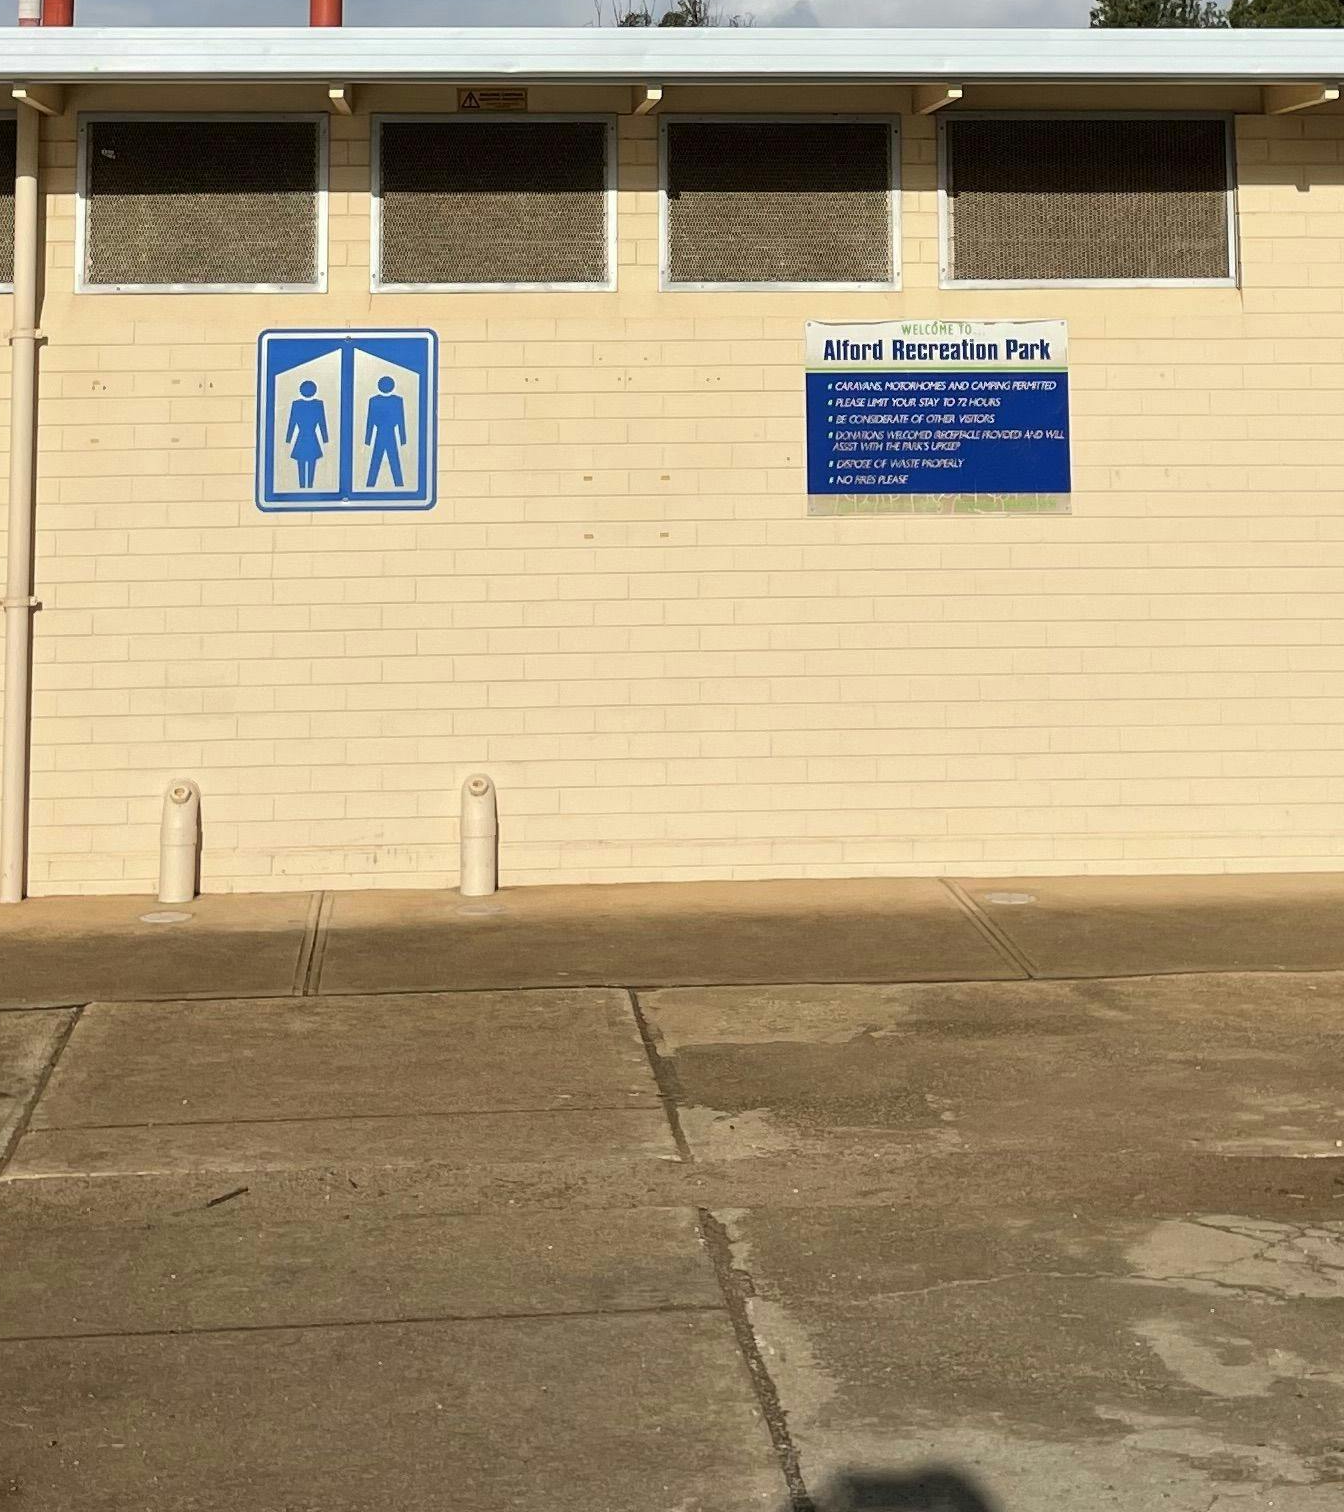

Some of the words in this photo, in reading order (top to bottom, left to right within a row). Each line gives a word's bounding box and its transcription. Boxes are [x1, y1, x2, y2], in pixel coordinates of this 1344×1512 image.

[901, 324, 952, 335] WELCOME
[824, 339, 883, 360] Alford
[893, 339, 998, 360] Recreation
[1006, 339, 1051, 360] Park
[835, 382, 883, 391] CARAVANS,
[885, 381, 946, 390] MOTORHOMES
[948, 381, 969, 390] AND
[971, 381, 1011, 390] CAMPING
[1012, 381, 1057, 390] PERMITTED
[835, 398, 865, 407] PLEASE
[867, 398, 889, 407] LIMIT
[891, 398, 916, 407] YOUR
[919, 398, 940, 407] STAY
[943, 398, 955, 407] TO
[957, 398, 967, 407] 72
[969, 398, 1001, 407] HOURS
[835, 415, 846, 424] BE
[849, 415, 911, 424] CONSIDERATE
[911, 414, 924, 423] OF
[926, 414, 955, 423] OTHER
[959, 414, 996, 424] VISITORS
[835, 431, 884, 440] DONATIONS
[886, 430, 933, 440] WELCOMED
[1024, 430, 1044, 439] AND
[1045, 430, 1064, 439] WILL
[832, 442, 859, 451] ASSIST
[861, 442, 883, 451] WITH
[886, 442, 901, 451] THE
[931, 442, 961, 451] UPKEEP
[836, 459, 872, 469] DISPOSE
[874, 459, 886, 468] OF
[890, 458, 920, 468] WASTE
[922, 458, 965, 468] PROPERLY
[836, 476, 853, 484] NO
[854, 475, 876, 484] FIRES
[878, 475, 909, 484] PLEASE
